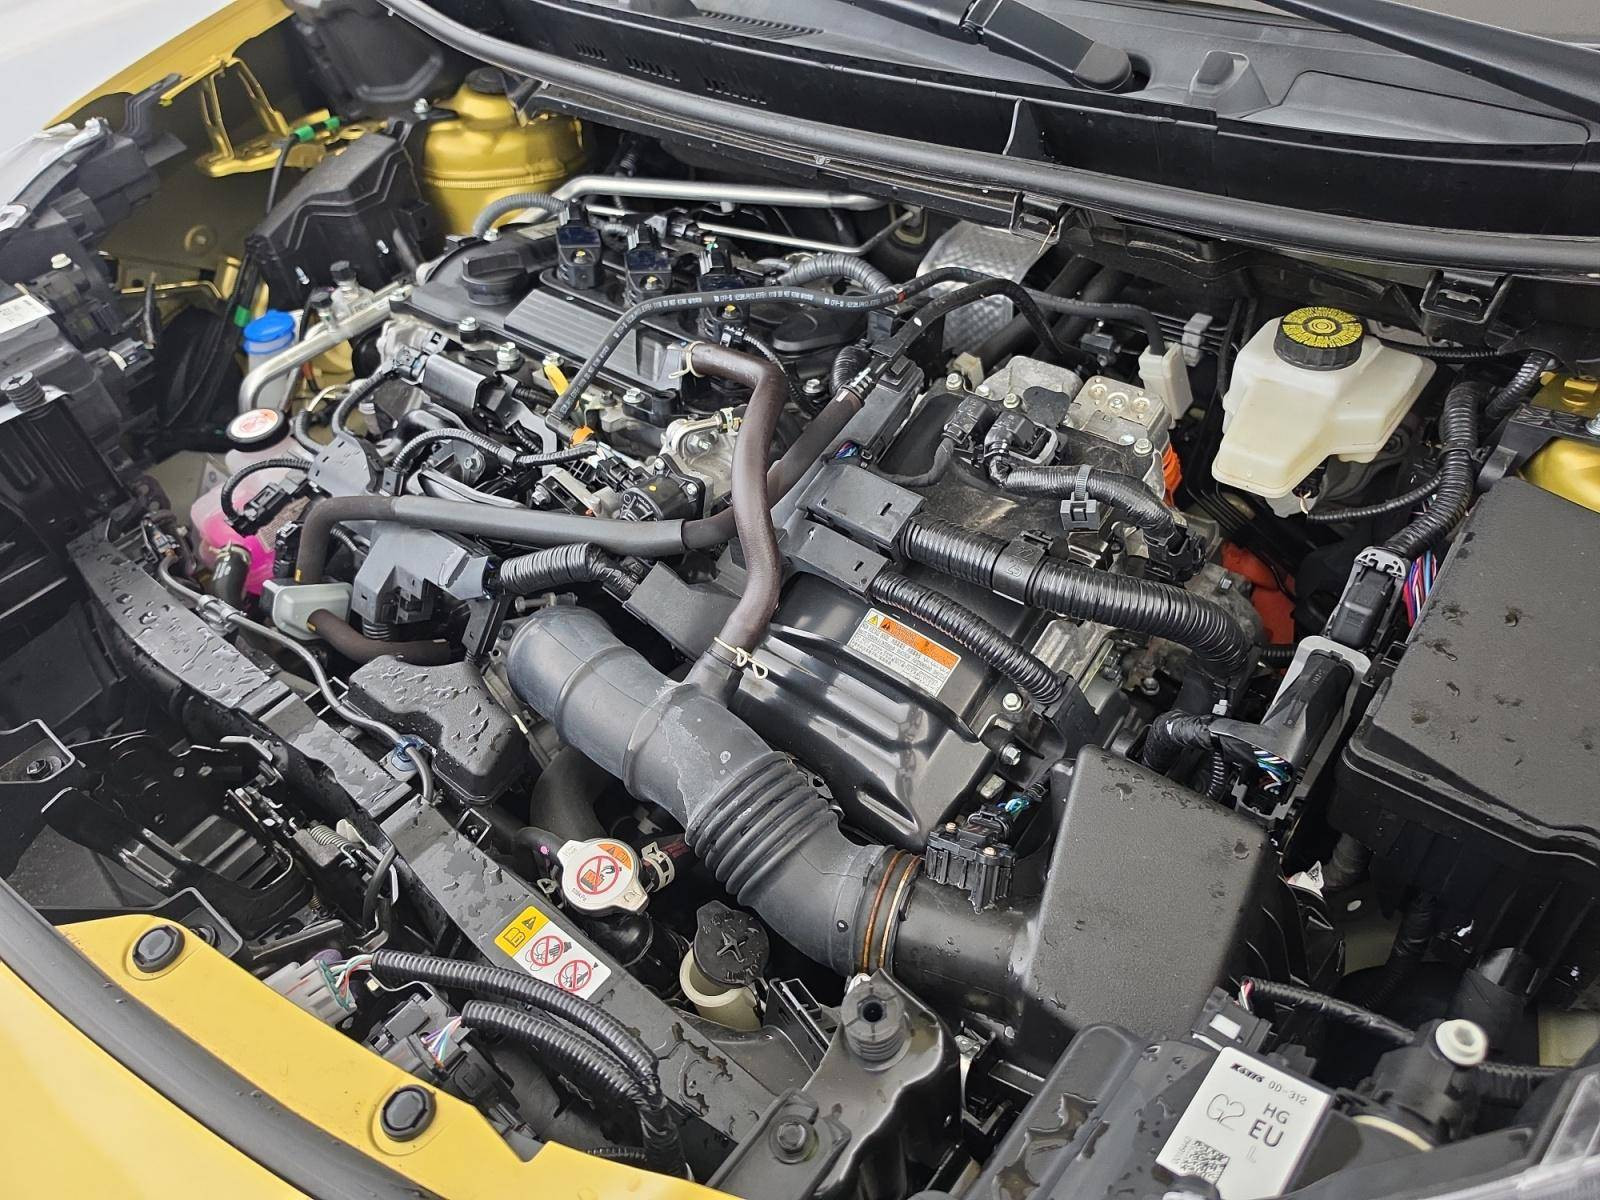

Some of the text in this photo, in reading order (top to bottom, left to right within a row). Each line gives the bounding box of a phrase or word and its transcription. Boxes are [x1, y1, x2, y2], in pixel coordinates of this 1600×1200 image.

[1206, 1093, 1246, 1131] G2
[1263, 1102, 1290, 1125] HG
[1248, 1118, 1284, 1148] EU
